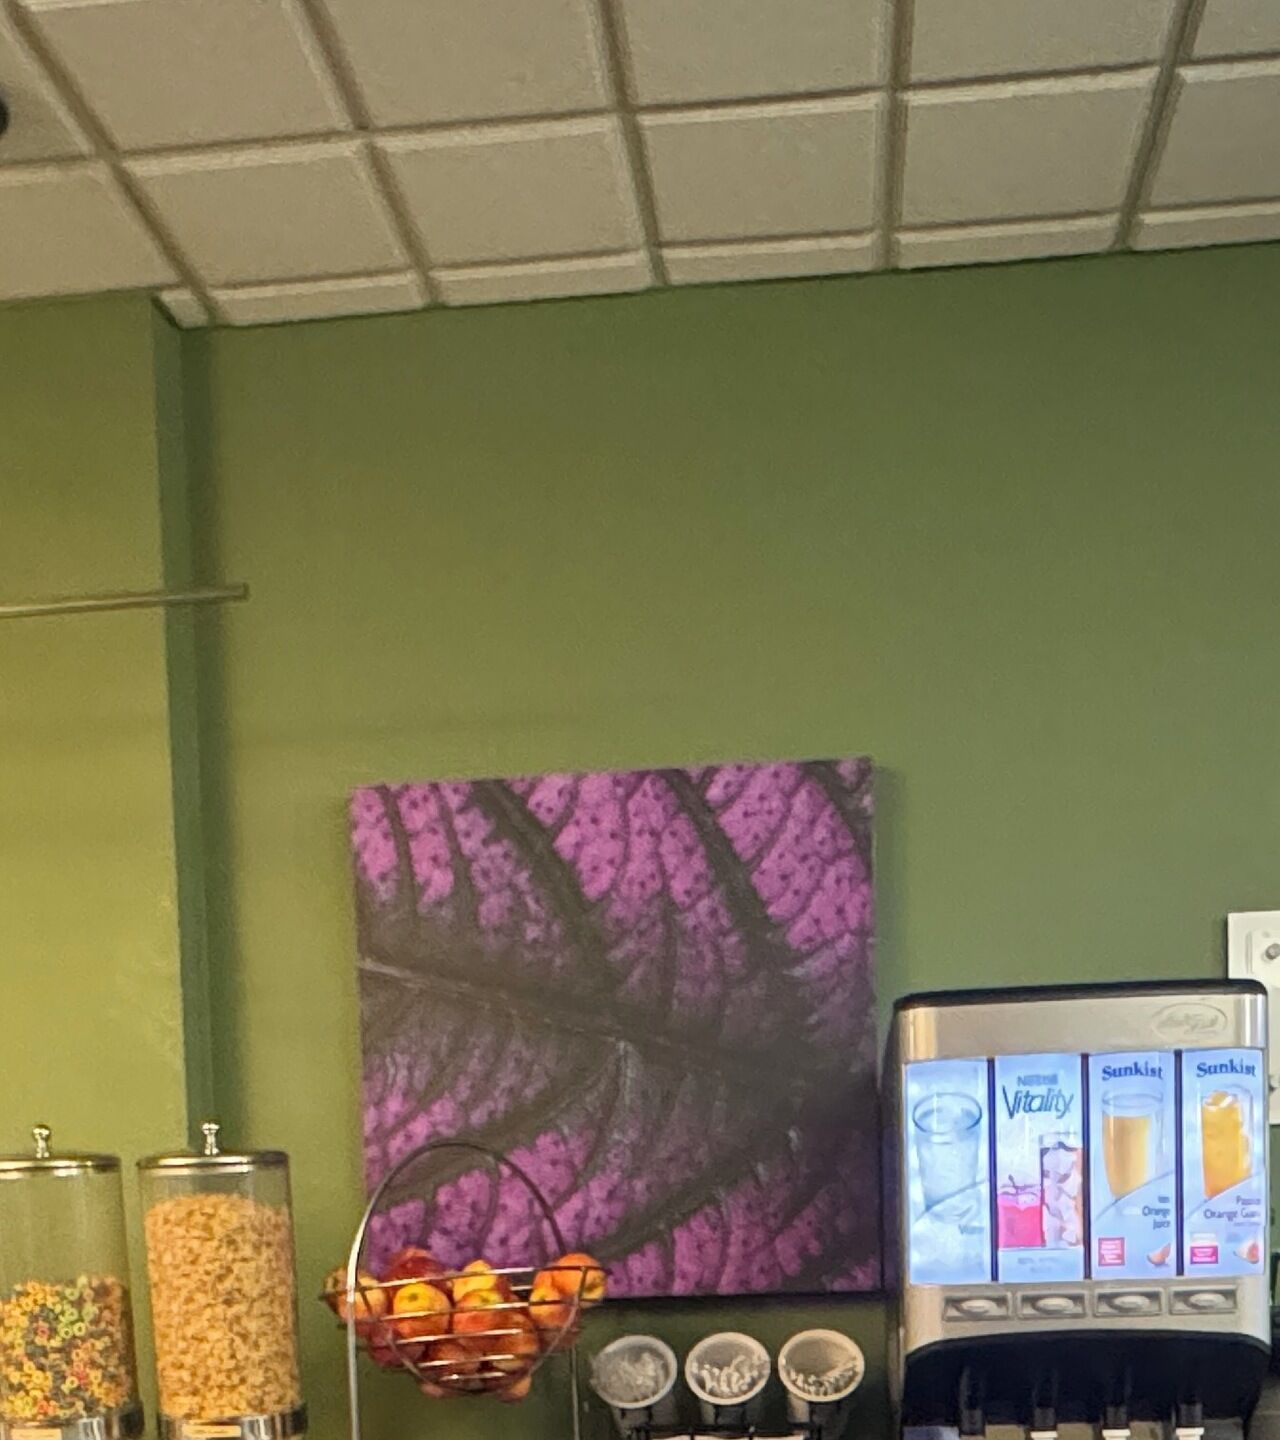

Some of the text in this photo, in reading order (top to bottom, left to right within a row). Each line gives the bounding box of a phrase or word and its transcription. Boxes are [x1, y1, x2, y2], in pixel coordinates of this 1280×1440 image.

[1101, 1060, 1163, 1081] Sunkist
[1196, 1057, 1257, 1079] Sunkist
[1002, 1084, 1074, 1120] Vitality
